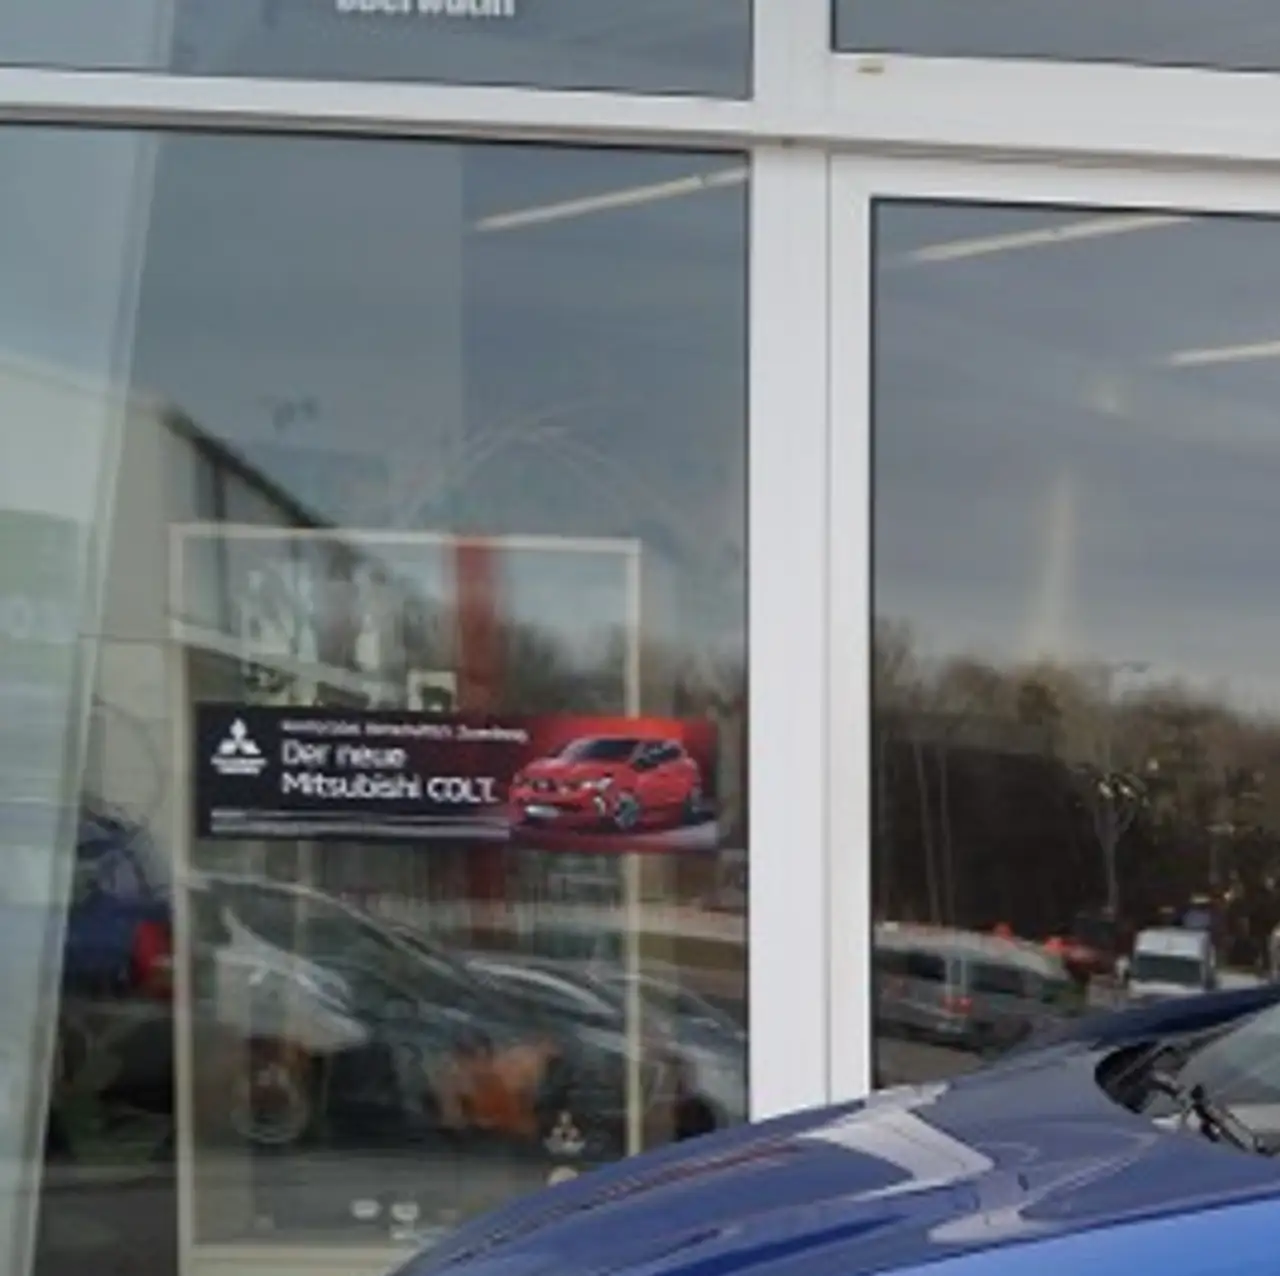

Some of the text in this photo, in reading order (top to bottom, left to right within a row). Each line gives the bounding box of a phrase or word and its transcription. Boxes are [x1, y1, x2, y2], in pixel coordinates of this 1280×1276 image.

[280, 739, 331, 766] Der
[336, 744, 406, 768] neue
[281, 772, 423, 799] Mitsubishi
